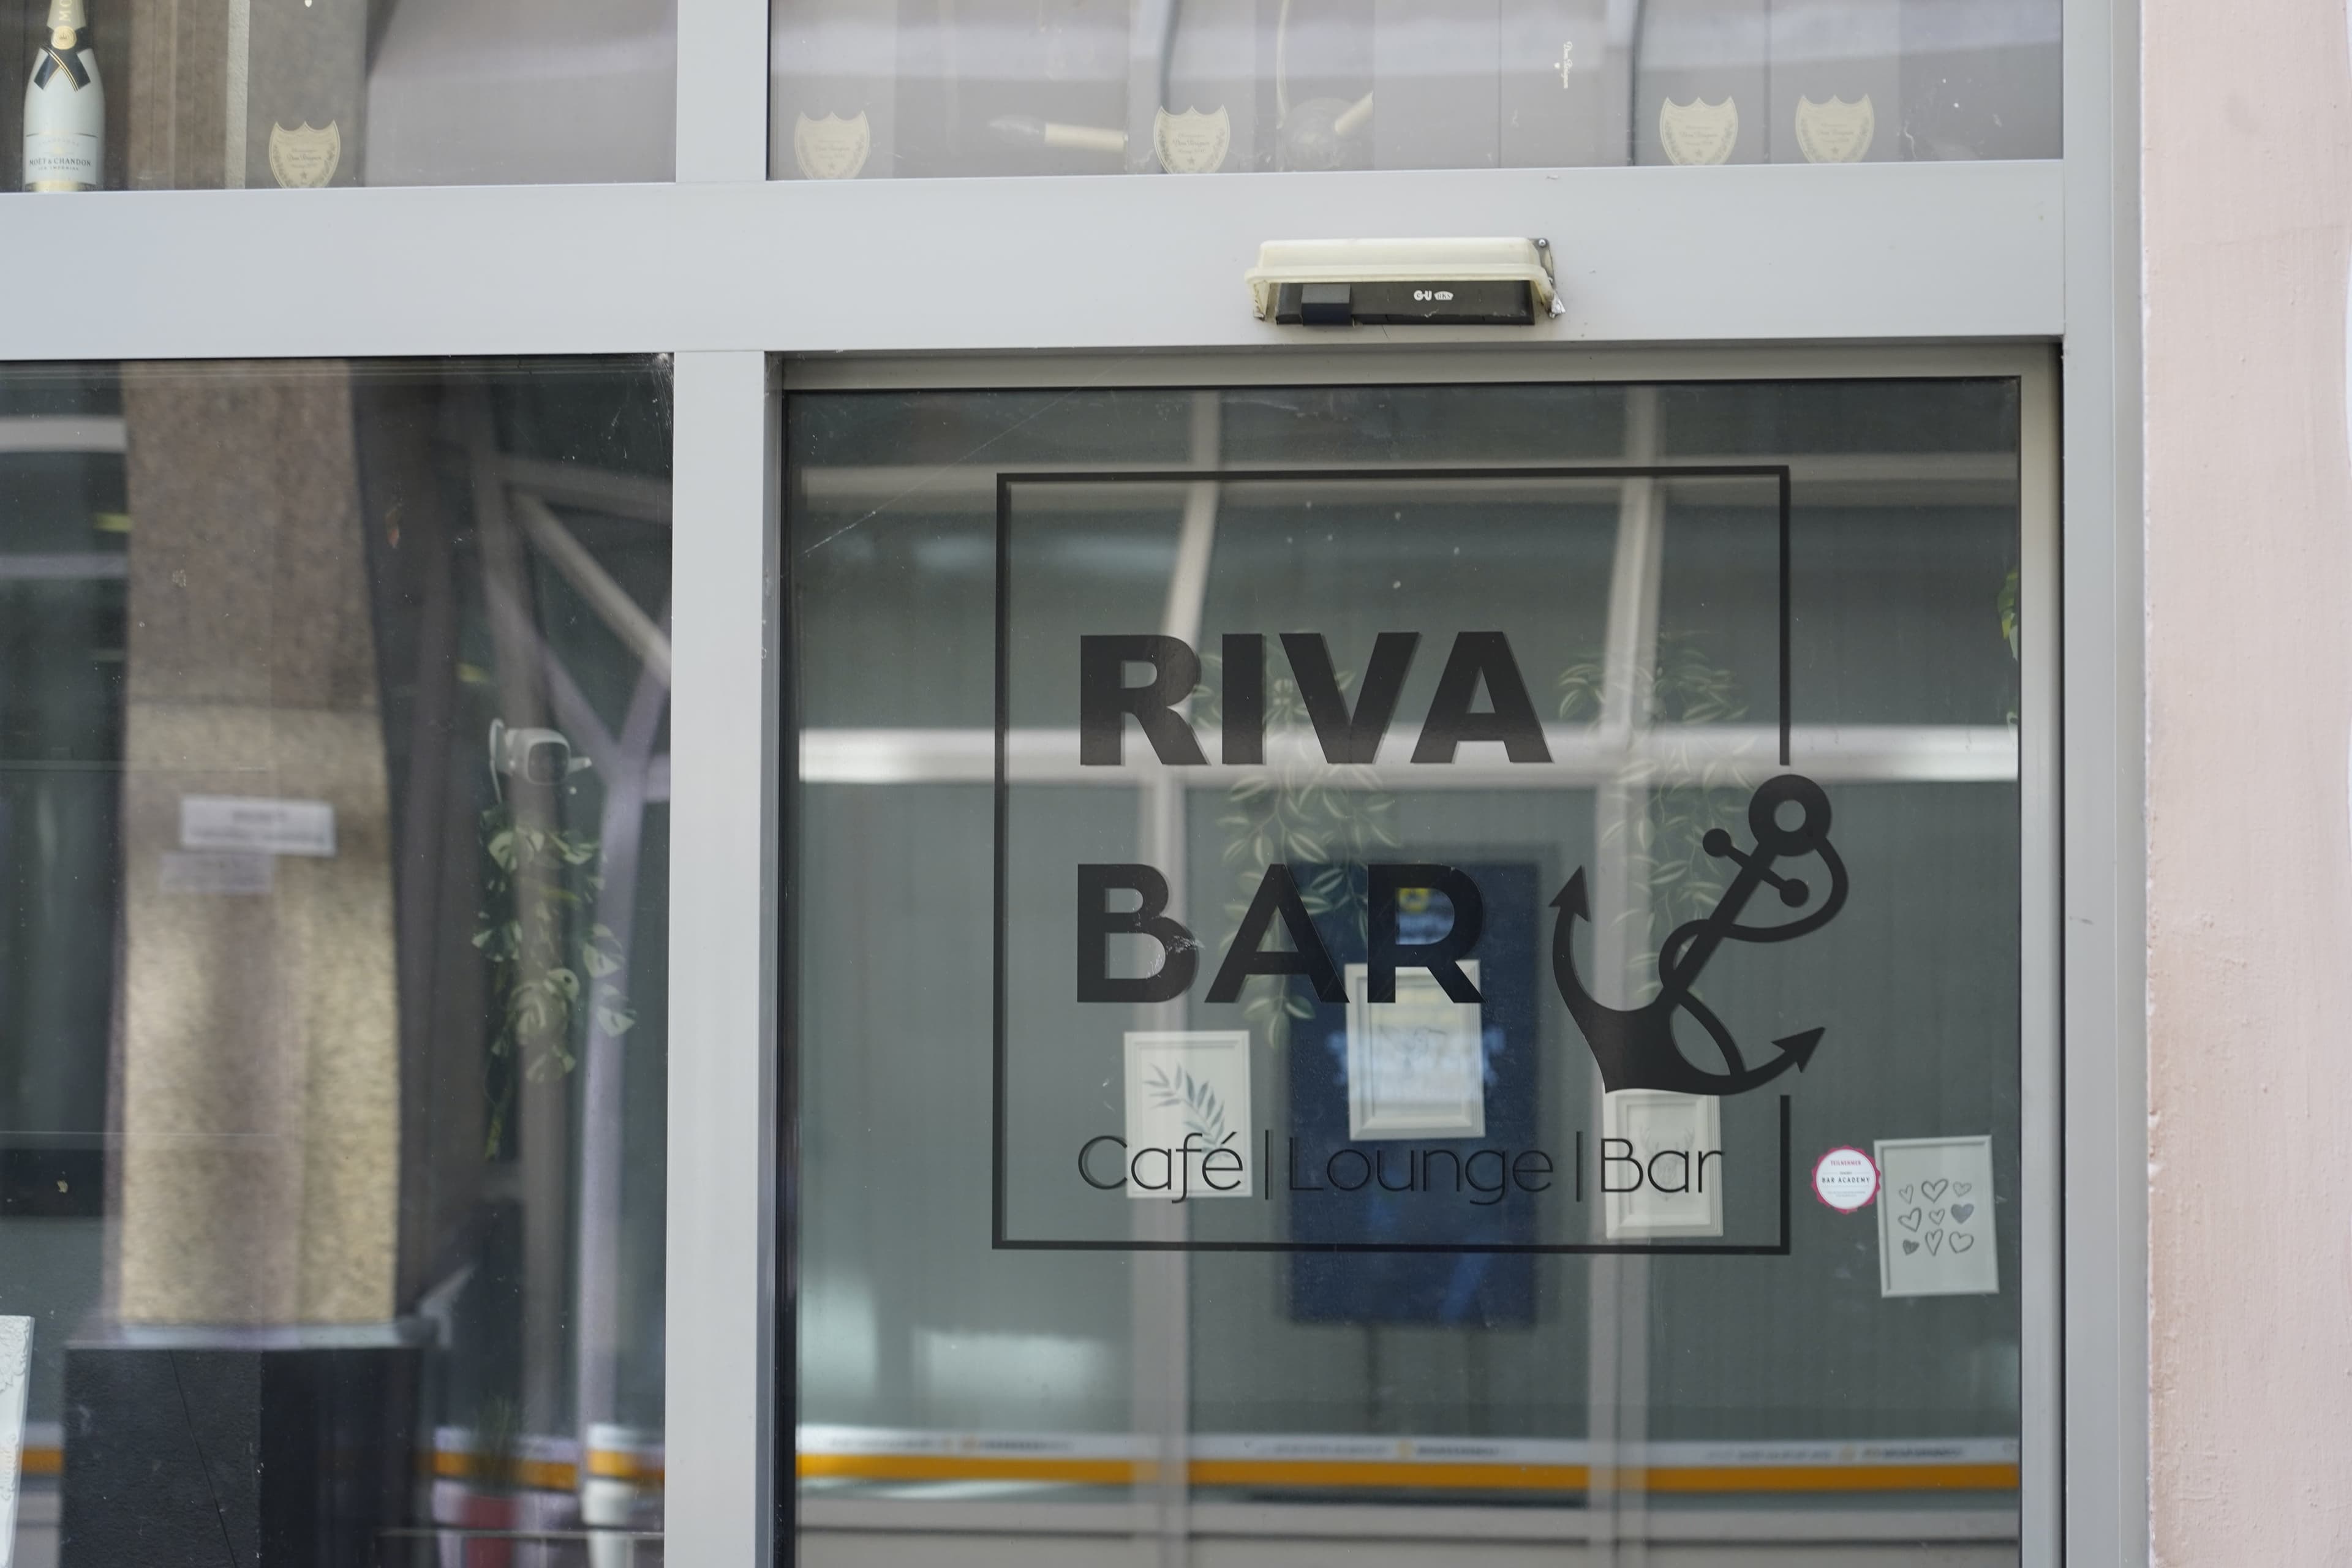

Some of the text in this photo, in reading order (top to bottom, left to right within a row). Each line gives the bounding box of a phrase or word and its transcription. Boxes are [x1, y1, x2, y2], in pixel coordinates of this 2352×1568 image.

[53, 157, 91, 167] CHANDON
[1080, 631, 1553, 766] RIVA
[1077, 863, 1487, 1004] BAR
[1078, 1131, 1243, 1204] Café
[1289, 1137, 1554, 1205] Lounge
[1601, 1138, 1725, 1193] Bar
